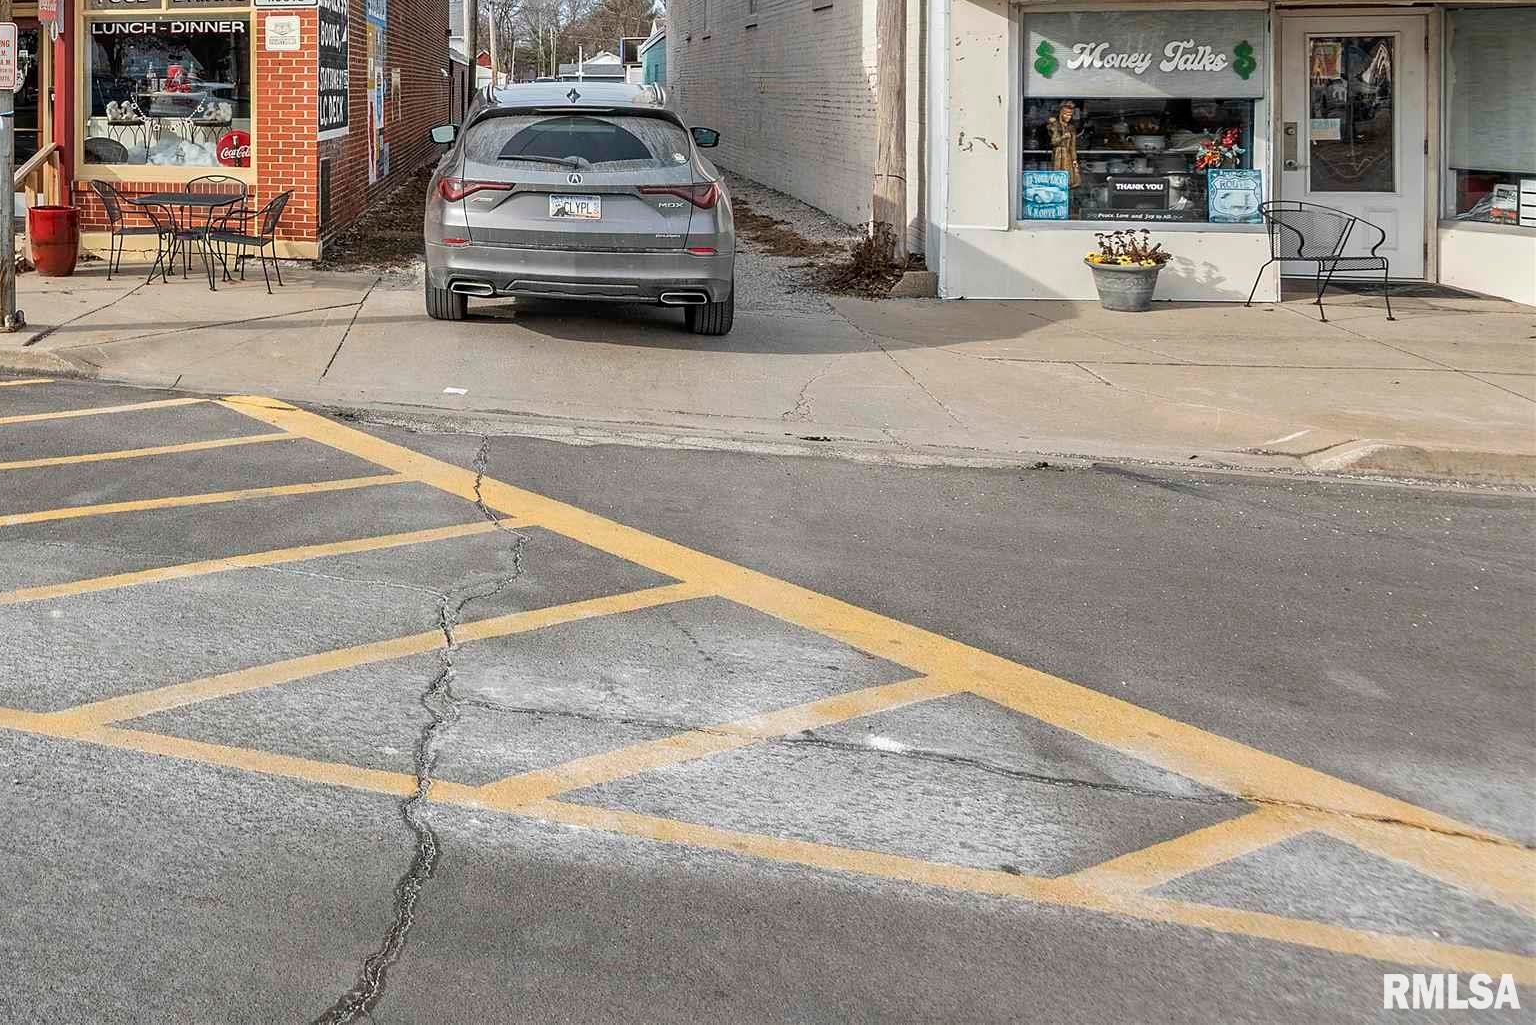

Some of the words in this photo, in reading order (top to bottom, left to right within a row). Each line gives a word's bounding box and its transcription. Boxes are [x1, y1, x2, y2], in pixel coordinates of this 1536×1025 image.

[92, 22, 156, 34] LUNCH
[170, 21, 245, 34] DINNER
[1066, 42, 1152, 74] Money
[1160, 39, 1228, 72] Talks
[1115, 183, 1144, 191] THANK
